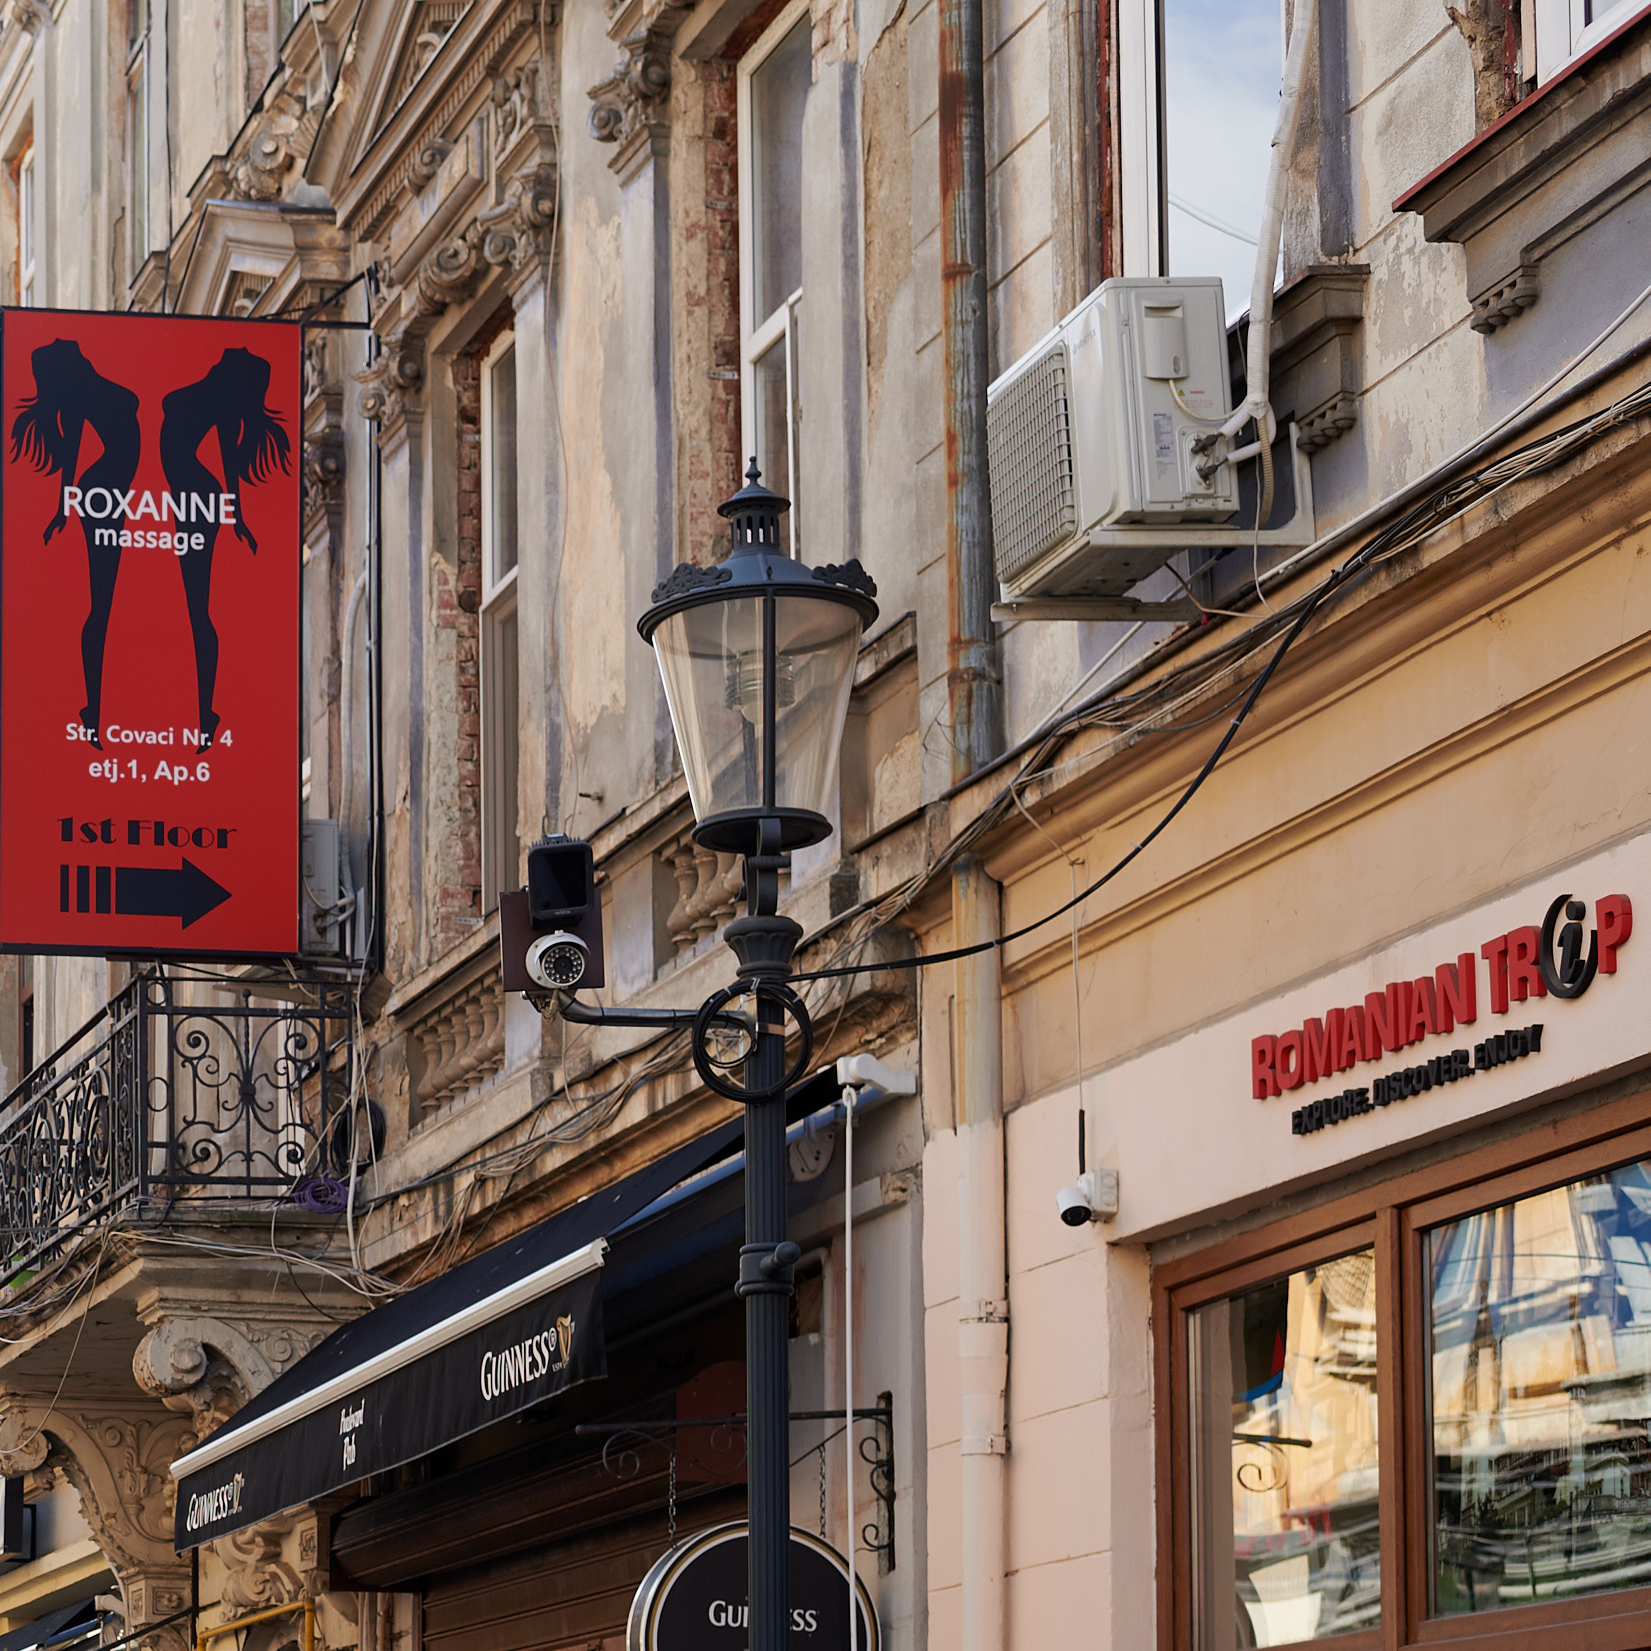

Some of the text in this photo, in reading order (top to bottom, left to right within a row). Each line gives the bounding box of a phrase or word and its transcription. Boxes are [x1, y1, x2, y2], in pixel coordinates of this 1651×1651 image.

[62, 486, 237, 525] ROXANNE
[94, 527, 205, 555] massage
[65, 723, 233, 747] Str. Covaci Nr. 4
[88, 758, 211, 785] etj.1, Ap.6
[57, 817, 237, 849] 1st Floor
[1251, 952, 1477, 1100] ROMANIAN
[1475, 1024, 1544, 1072] ENJOY
[708, 1600, 818, 1632] GUISS
